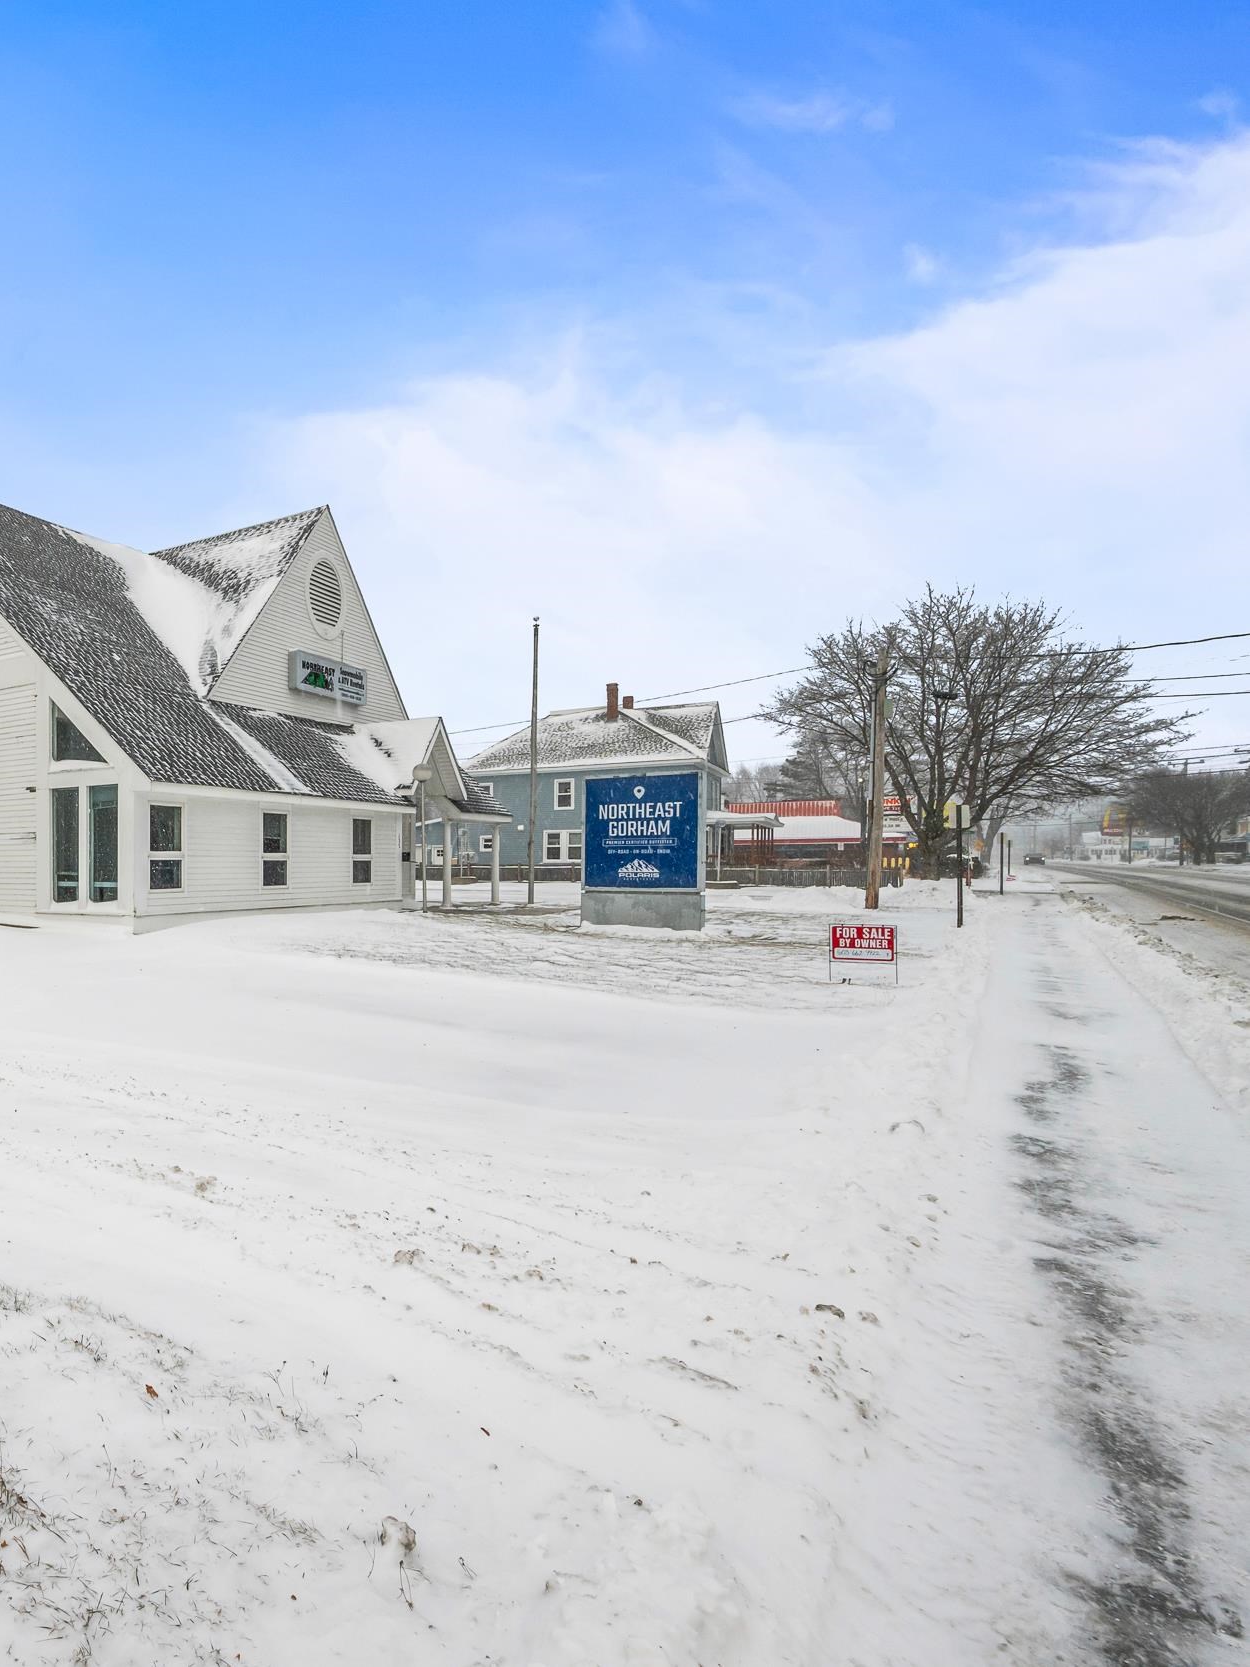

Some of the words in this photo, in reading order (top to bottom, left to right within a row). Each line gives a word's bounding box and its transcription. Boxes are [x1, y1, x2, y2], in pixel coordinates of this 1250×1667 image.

[599, 801, 683, 819] NORTHEAST
[608, 820, 670, 837] GORHAM
[836, 927, 857, 938] FOR
[862, 928, 892, 939] SALE
[839, 938, 851, 947] BY
[854, 938, 889, 949] OWNER
